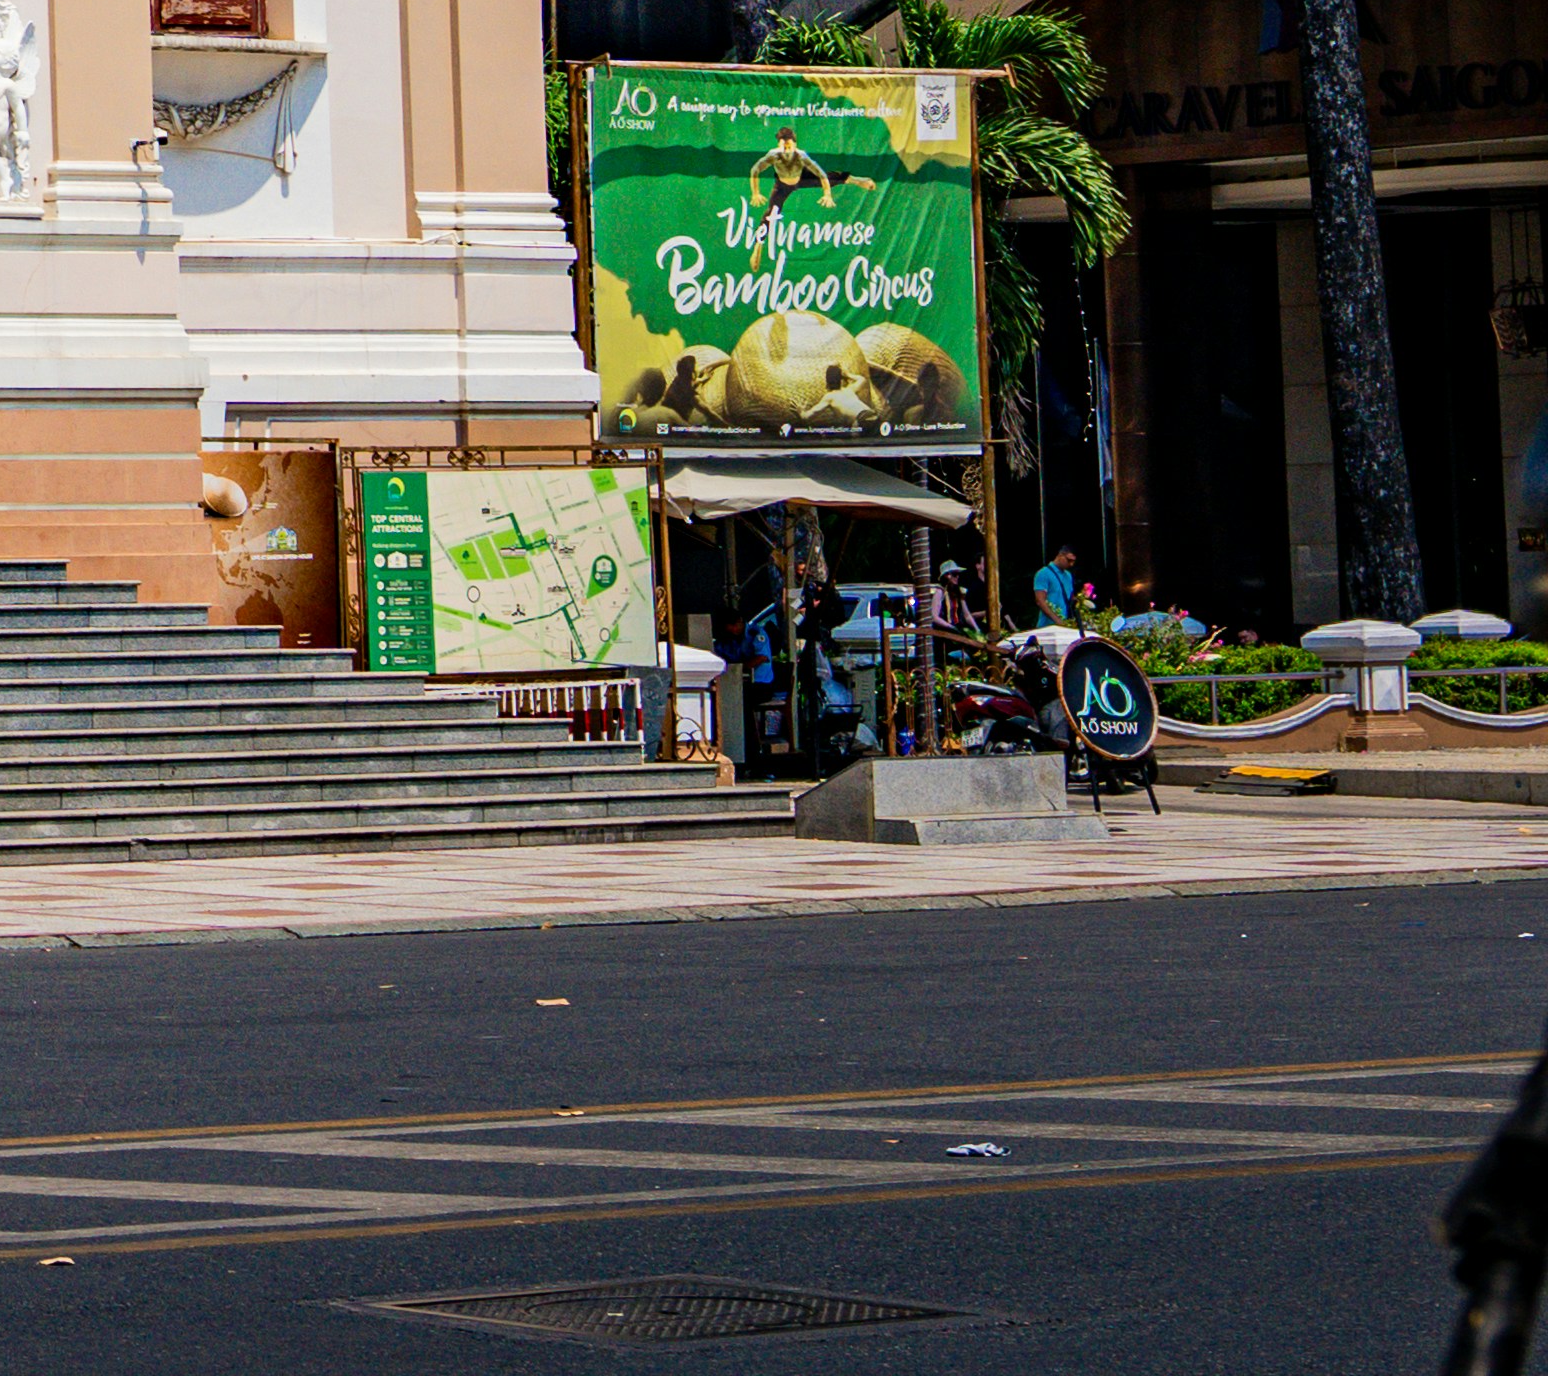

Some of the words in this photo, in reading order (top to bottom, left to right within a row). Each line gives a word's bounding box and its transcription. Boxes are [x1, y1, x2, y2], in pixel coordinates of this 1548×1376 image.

[1381, 58, 1548, 117] SAIGO
[667, 96, 679, 113] A
[739, 99, 752, 116] to
[717, 195, 875, 261] Vietnamese
[656, 236, 840, 315] Bamboo
[844, 255, 935, 311] Circus
[371, 514, 387, 523] TOP
[388, 514, 423, 523] CENTRAL
[372, 524, 423, 533] ATTRACTIONS
[1100, 720, 1138, 735] SHOW
